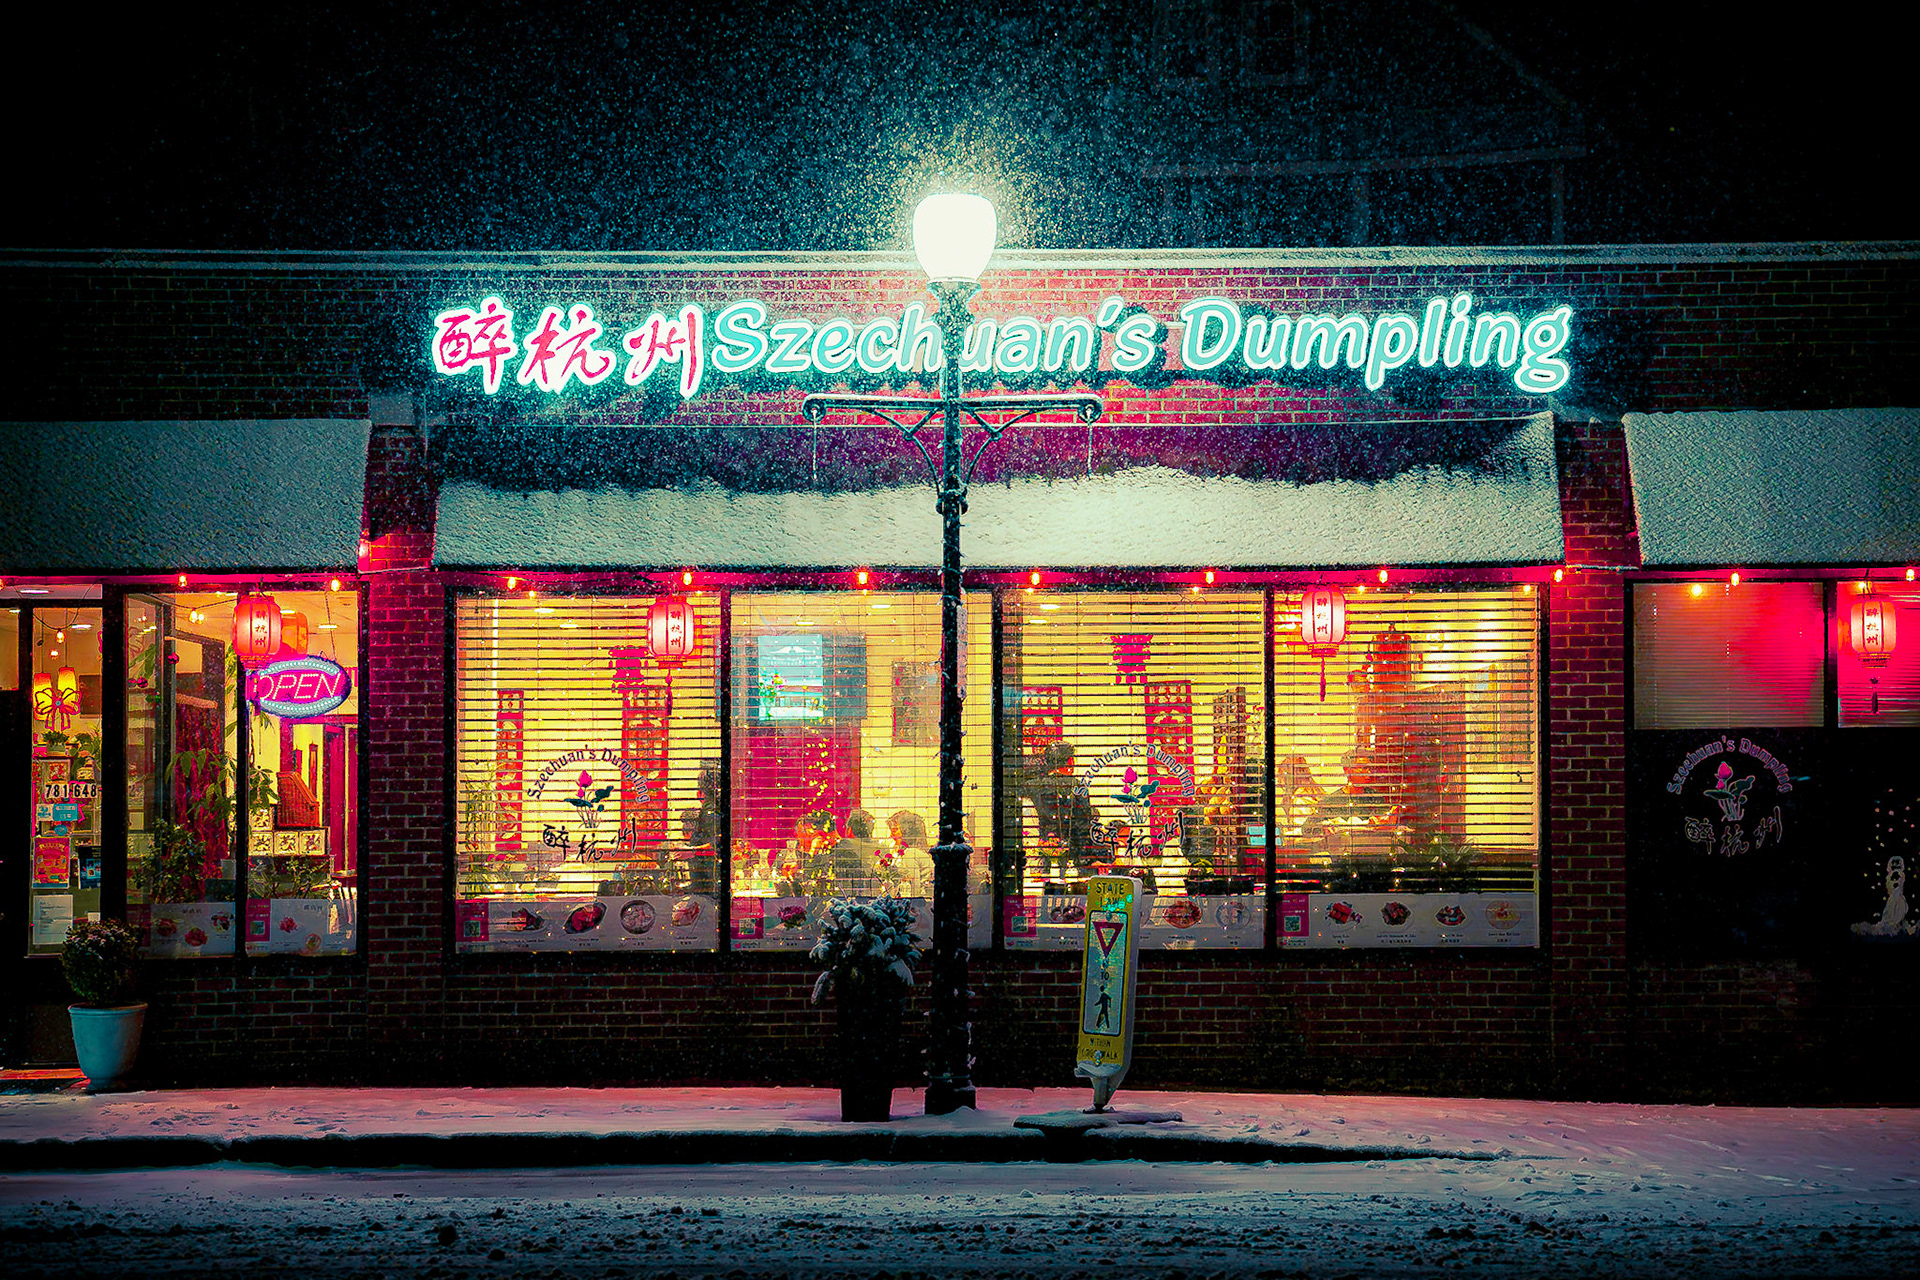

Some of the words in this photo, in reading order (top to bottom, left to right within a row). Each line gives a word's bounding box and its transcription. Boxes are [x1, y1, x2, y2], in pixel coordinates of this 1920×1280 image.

[433, 297, 702, 398] 醉杭州
[711, 300, 1158, 373] Szechuan's
[1181, 294, 1573, 393] Dumpling
[253, 673, 342, 700] OPEN
[527, 743, 597, 800] Szechuan's
[601, 747, 651, 803] Dumpling
[1073, 740, 1141, 797] Szechuan's
[1146, 743, 1196, 798] Dumpling
[1666, 734, 1736, 795] Szechuan's
[1739, 737, 1793, 793] Dumpling
[543, 817, 638, 864] 醉杭州
[1090, 810, 1186, 860] 醉杭州
[1685, 805, 1783, 858] 醉杭州
[1096, 882, 1125, 895] STATE
[1101, 971, 1110, 981] TO
